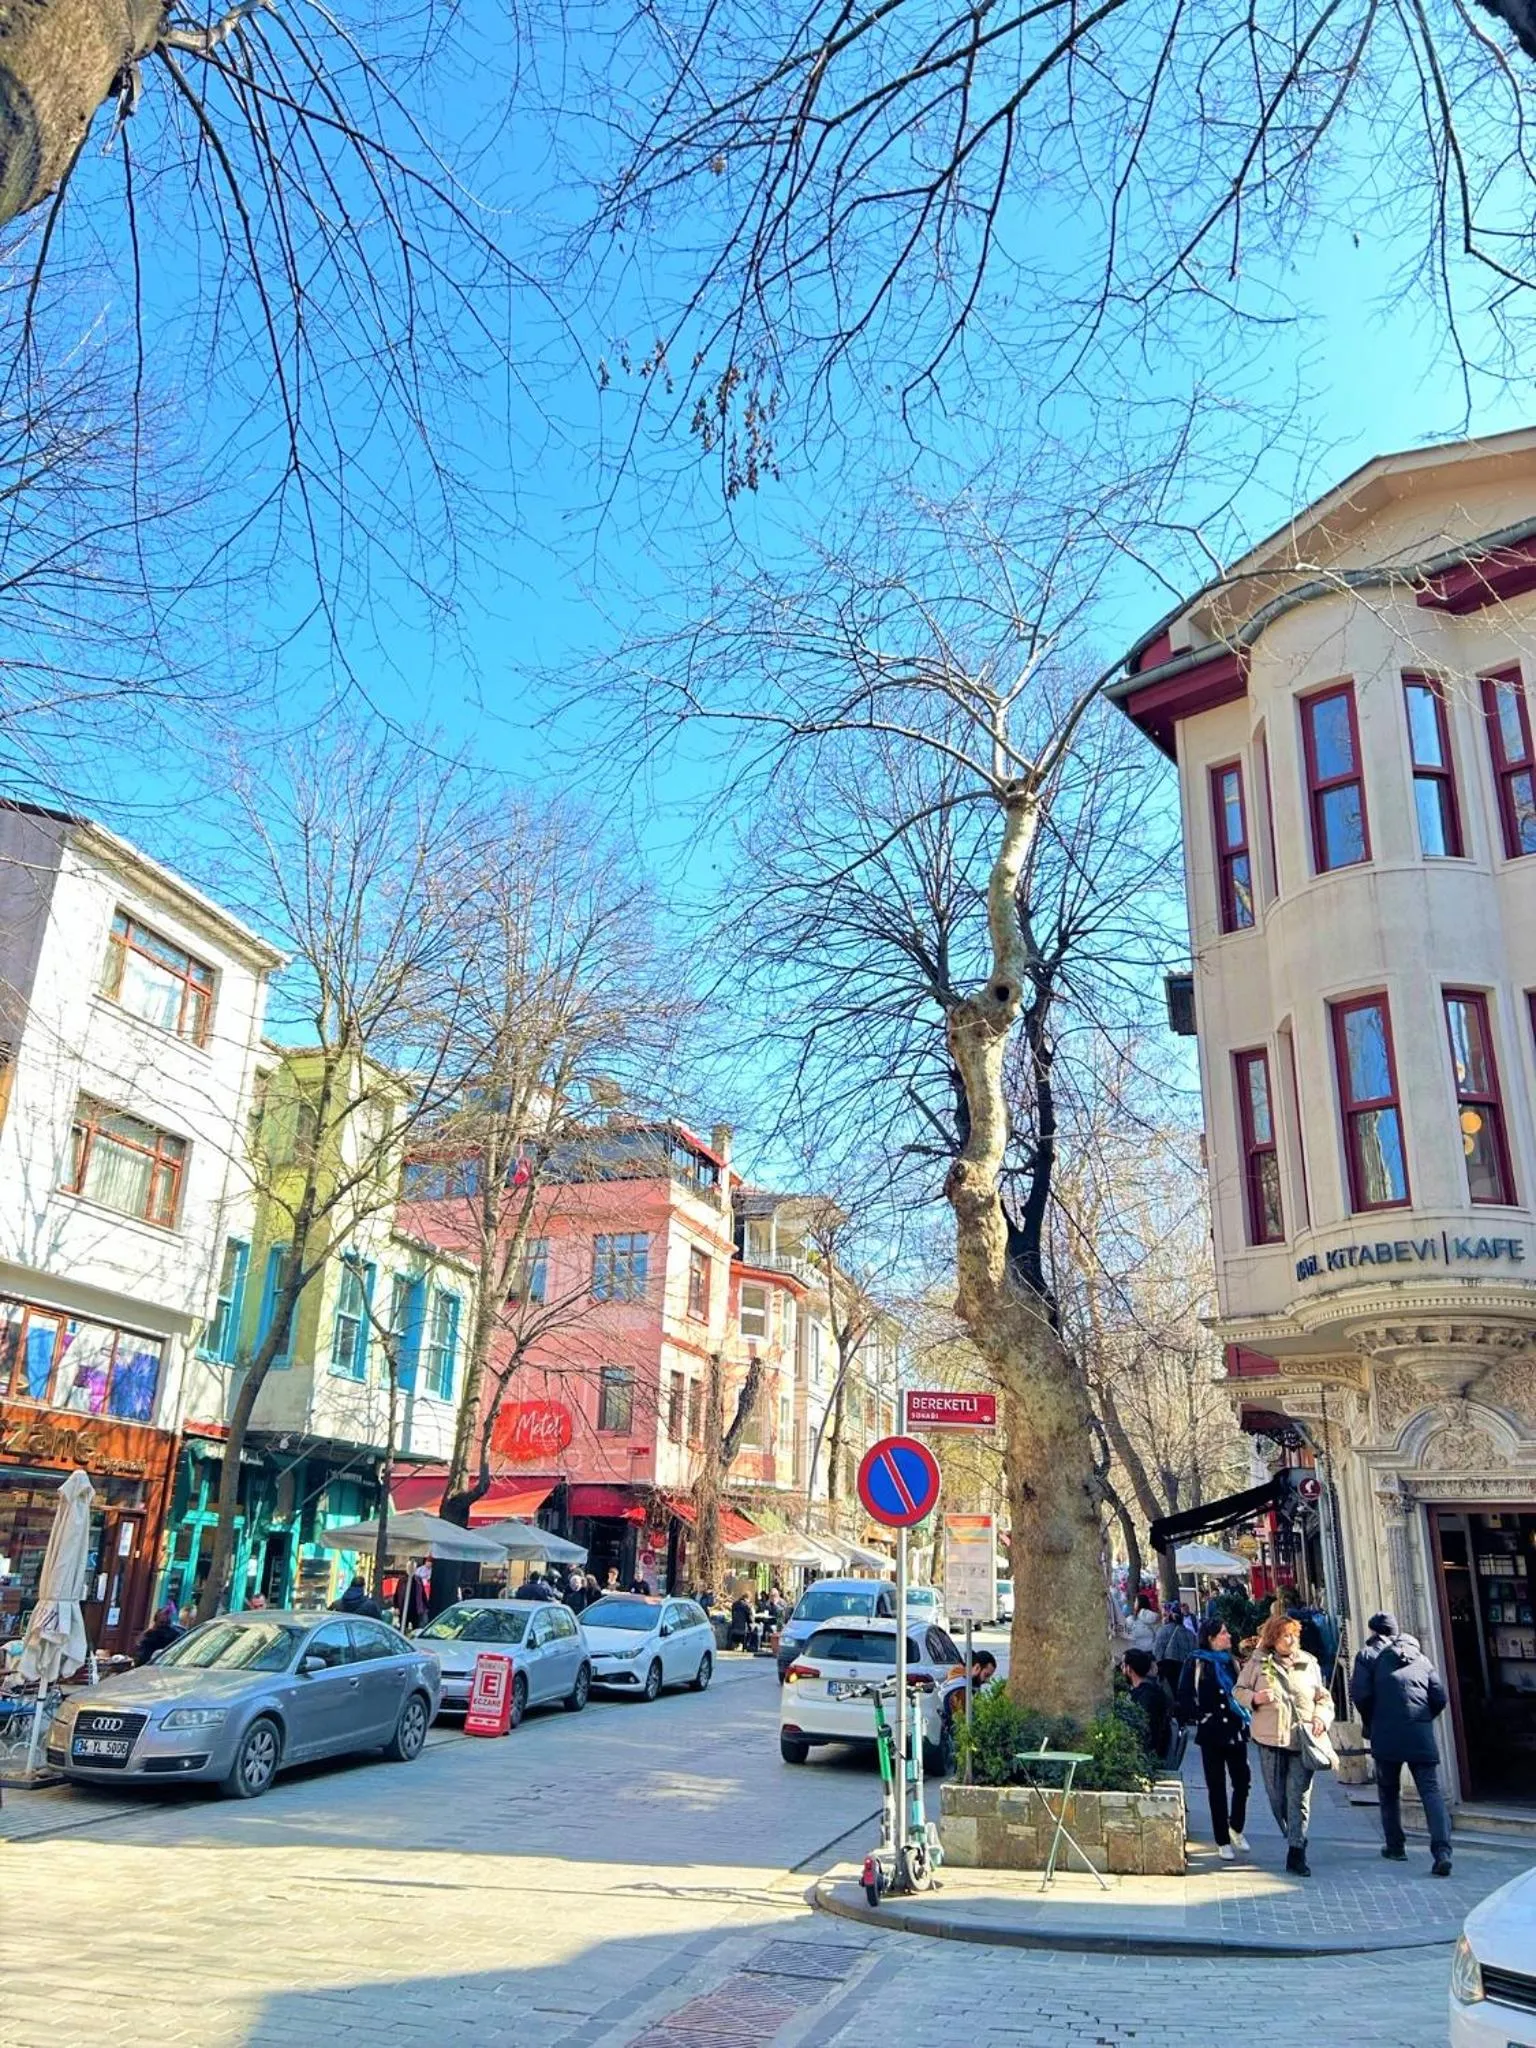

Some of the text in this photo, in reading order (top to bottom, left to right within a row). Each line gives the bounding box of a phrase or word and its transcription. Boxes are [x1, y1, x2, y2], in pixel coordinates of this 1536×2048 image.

[1454, 1236, 1526, 1263] KAFE
[912, 1396, 978, 1413] BEREKETLİ
[483, 1674, 498, 1694] E
